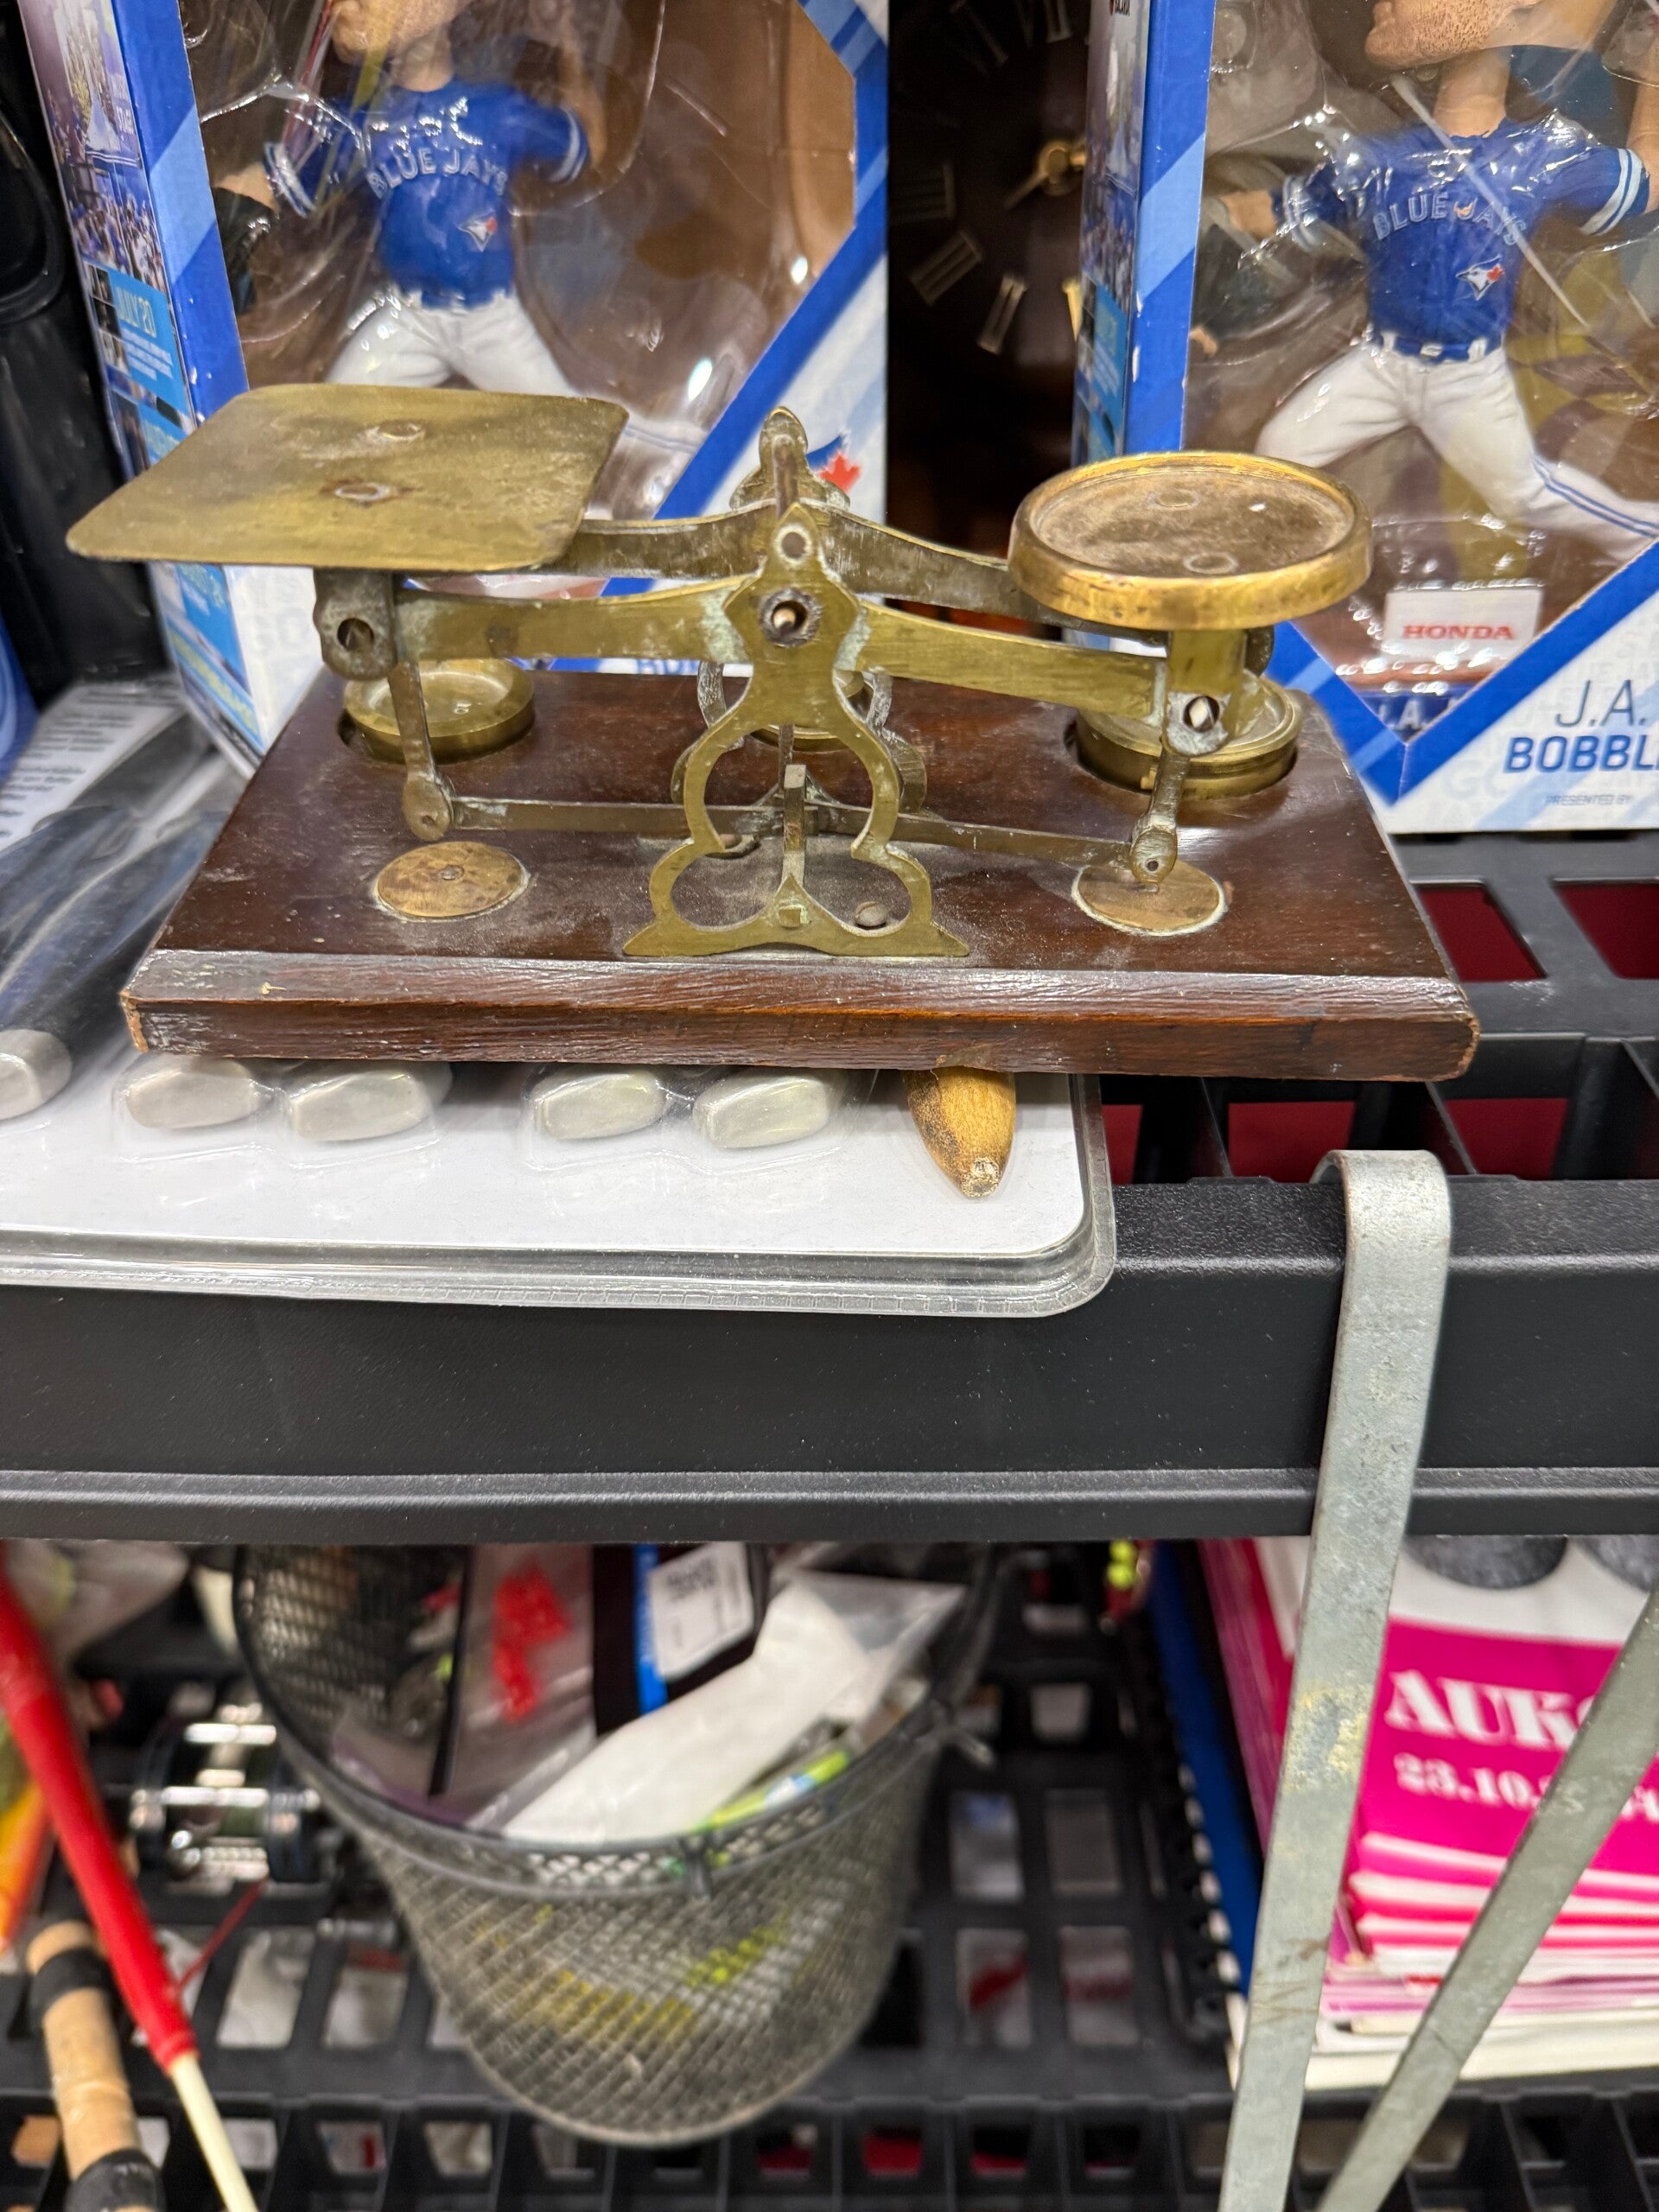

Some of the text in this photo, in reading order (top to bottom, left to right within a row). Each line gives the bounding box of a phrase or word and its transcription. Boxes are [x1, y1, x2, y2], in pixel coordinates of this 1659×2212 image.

[366, 148, 509, 200] BLUE JAYS
[1372, 191, 1527, 246] BLUE JAYS
[1402, 625, 1514, 640] HONDA
[1555, 679, 1648, 728] J.A.
[1503, 734, 1659, 773] BOBBL
[1383, 1669, 1596, 1752] AUK
